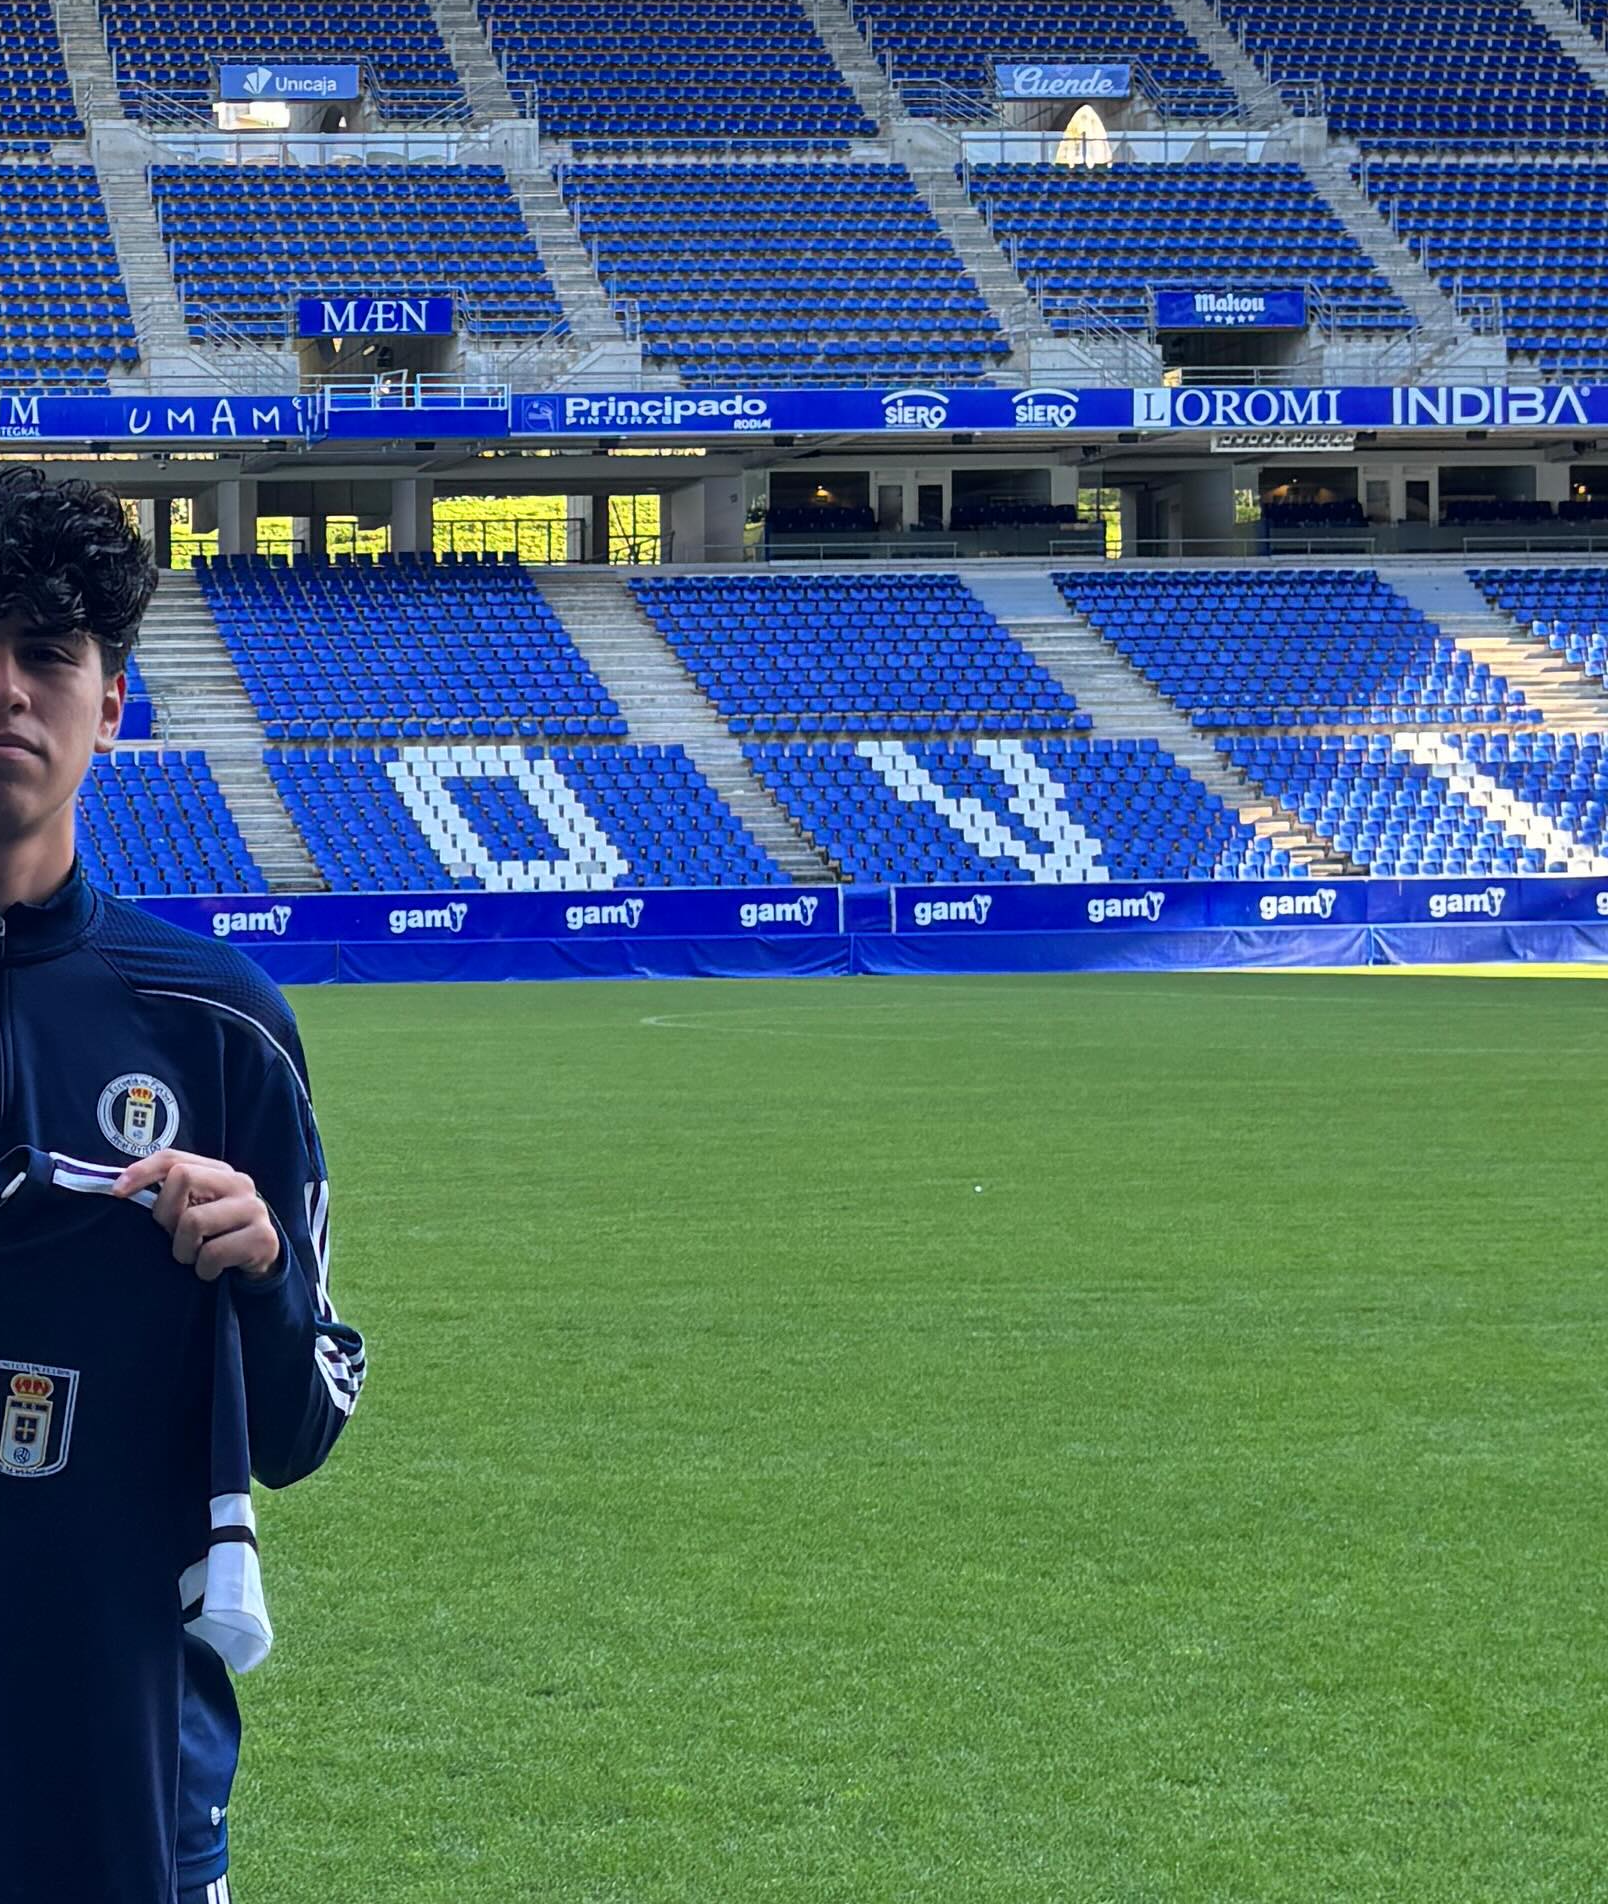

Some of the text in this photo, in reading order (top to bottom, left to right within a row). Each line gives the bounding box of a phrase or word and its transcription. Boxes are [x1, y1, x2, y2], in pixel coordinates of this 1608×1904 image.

[275, 76, 337, 96] Unicaja
[1012, 66, 1114, 95] Cuende
[321, 300, 429, 332] MÆN
[1194, 293, 1266, 312] Mahou
[566, 395, 767, 424] Principado
[566, 416, 673, 425] PINTURAS
[1142, 389, 1342, 425] LOROMI
